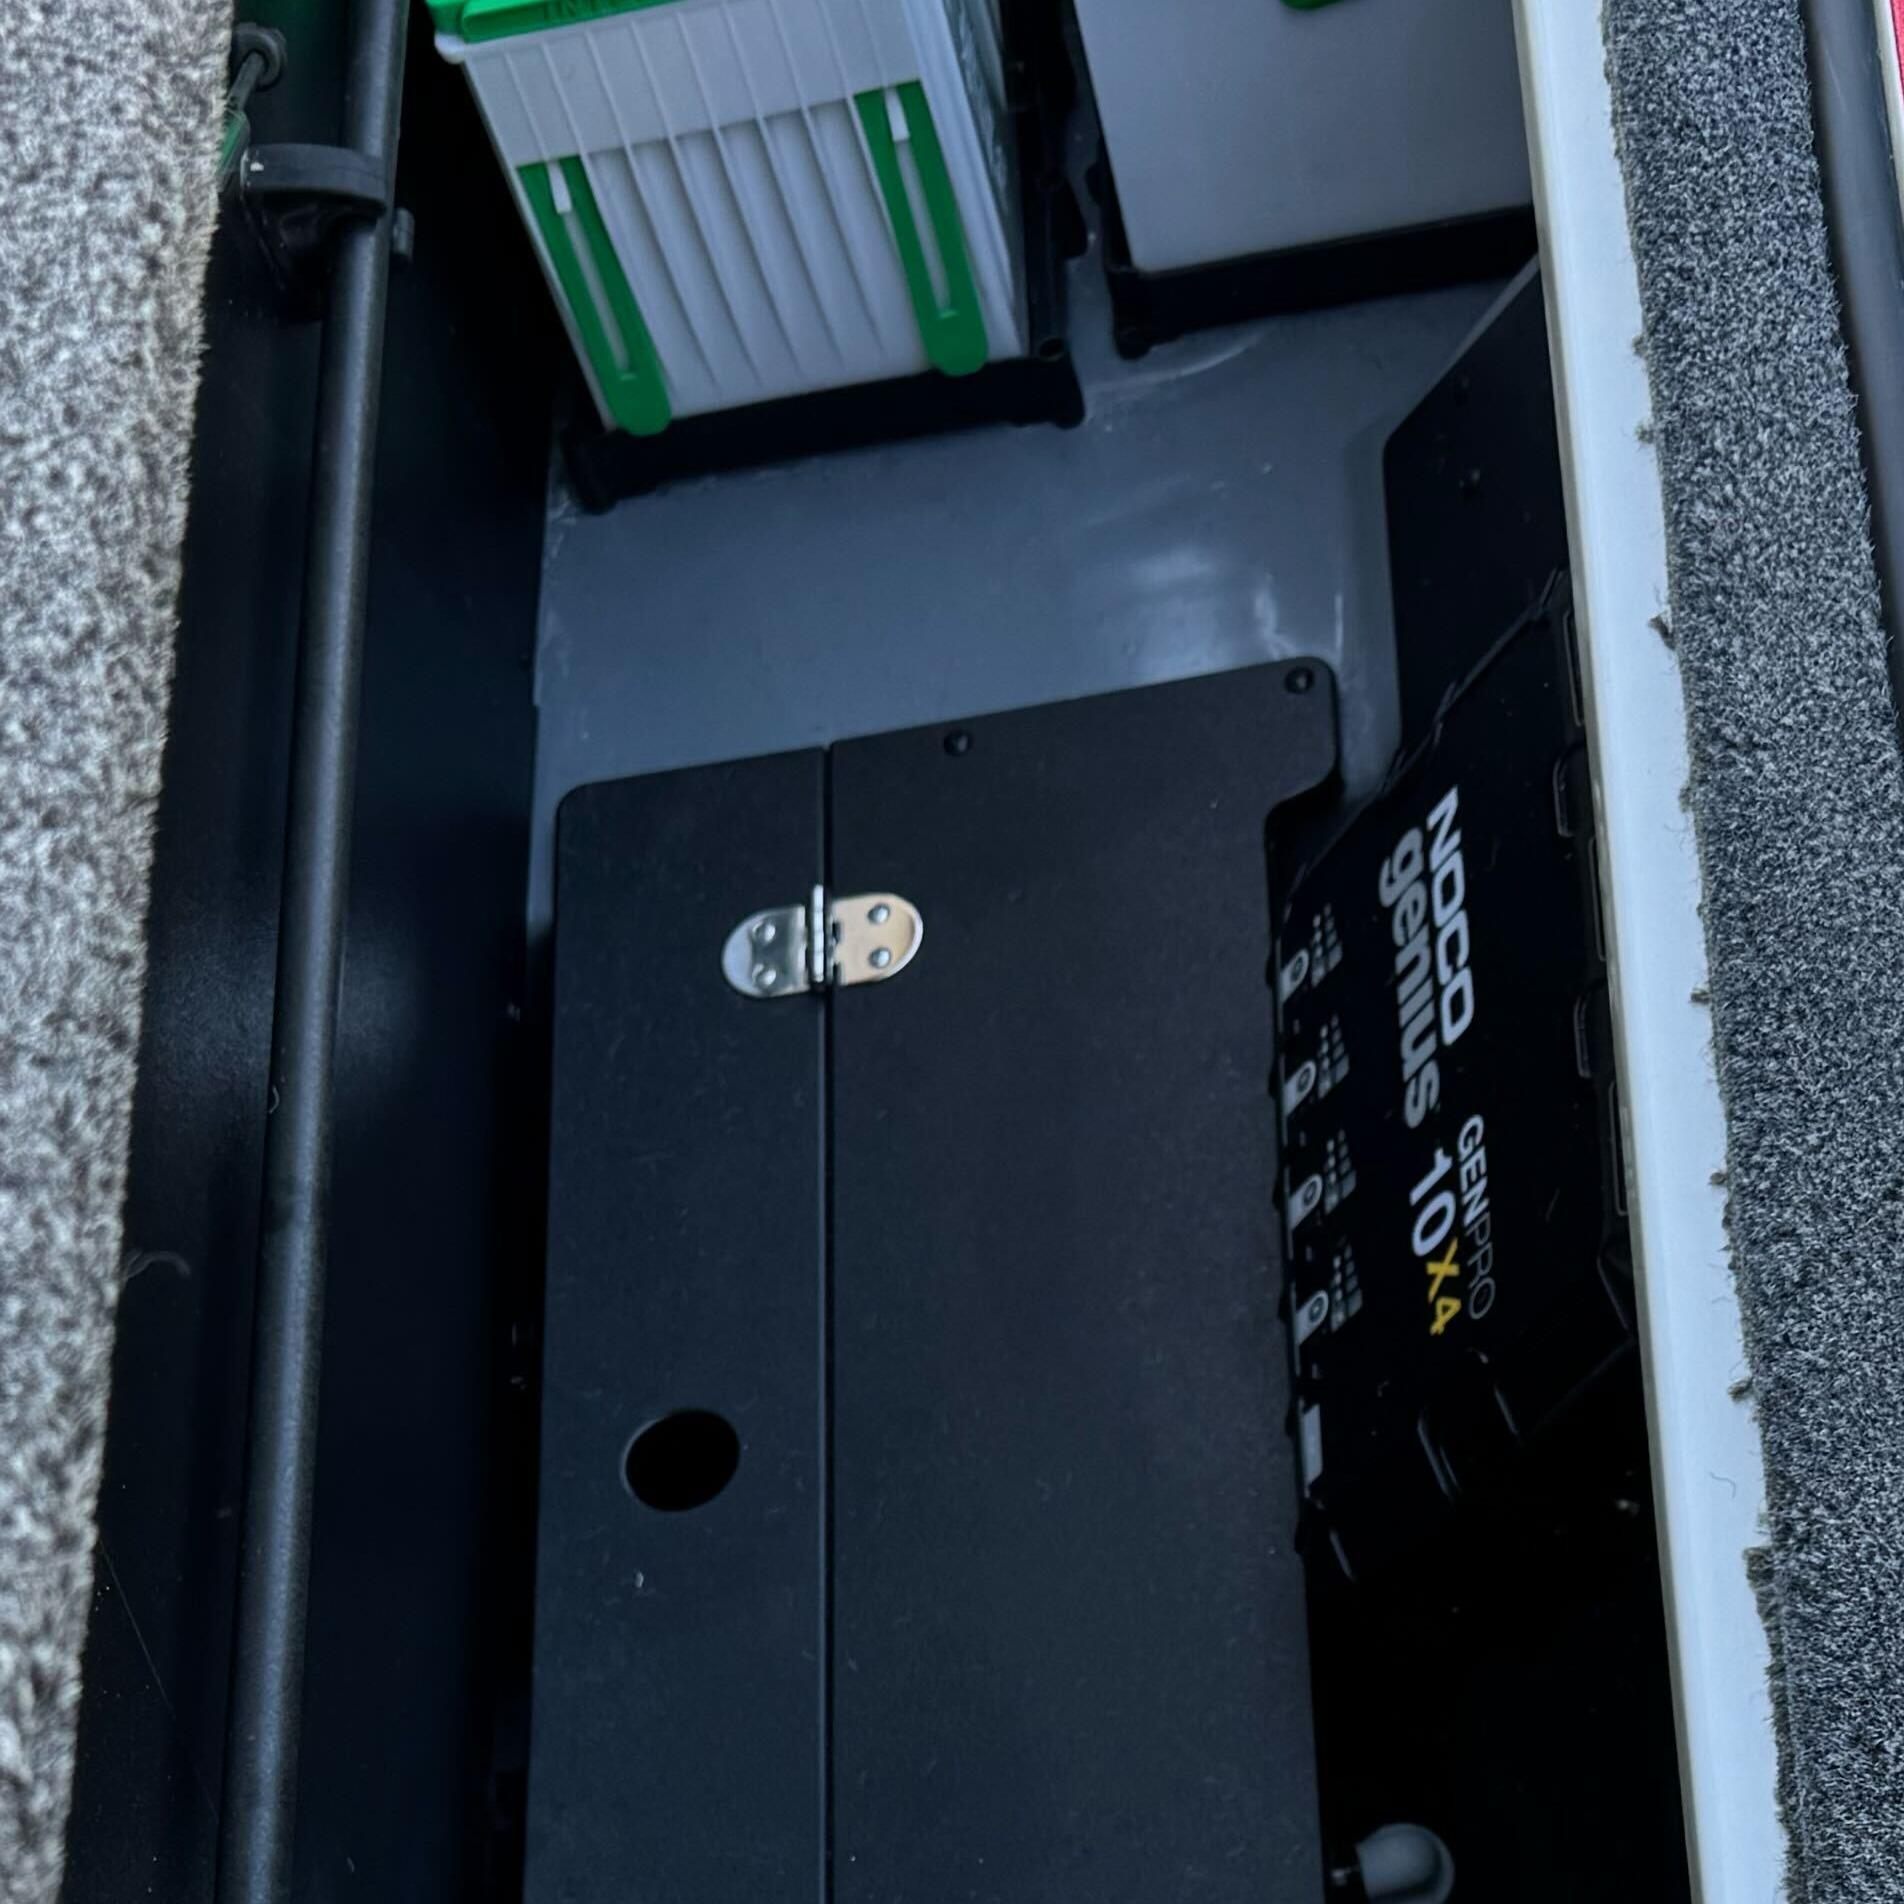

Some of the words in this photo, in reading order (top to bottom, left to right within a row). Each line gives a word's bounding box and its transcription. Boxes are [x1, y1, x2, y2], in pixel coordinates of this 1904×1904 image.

[1378, 828, 1441, 1128] genius
[1425, 786, 1475, 1046] NOCO
[1456, 1115, 1496, 1320] GENPRO
